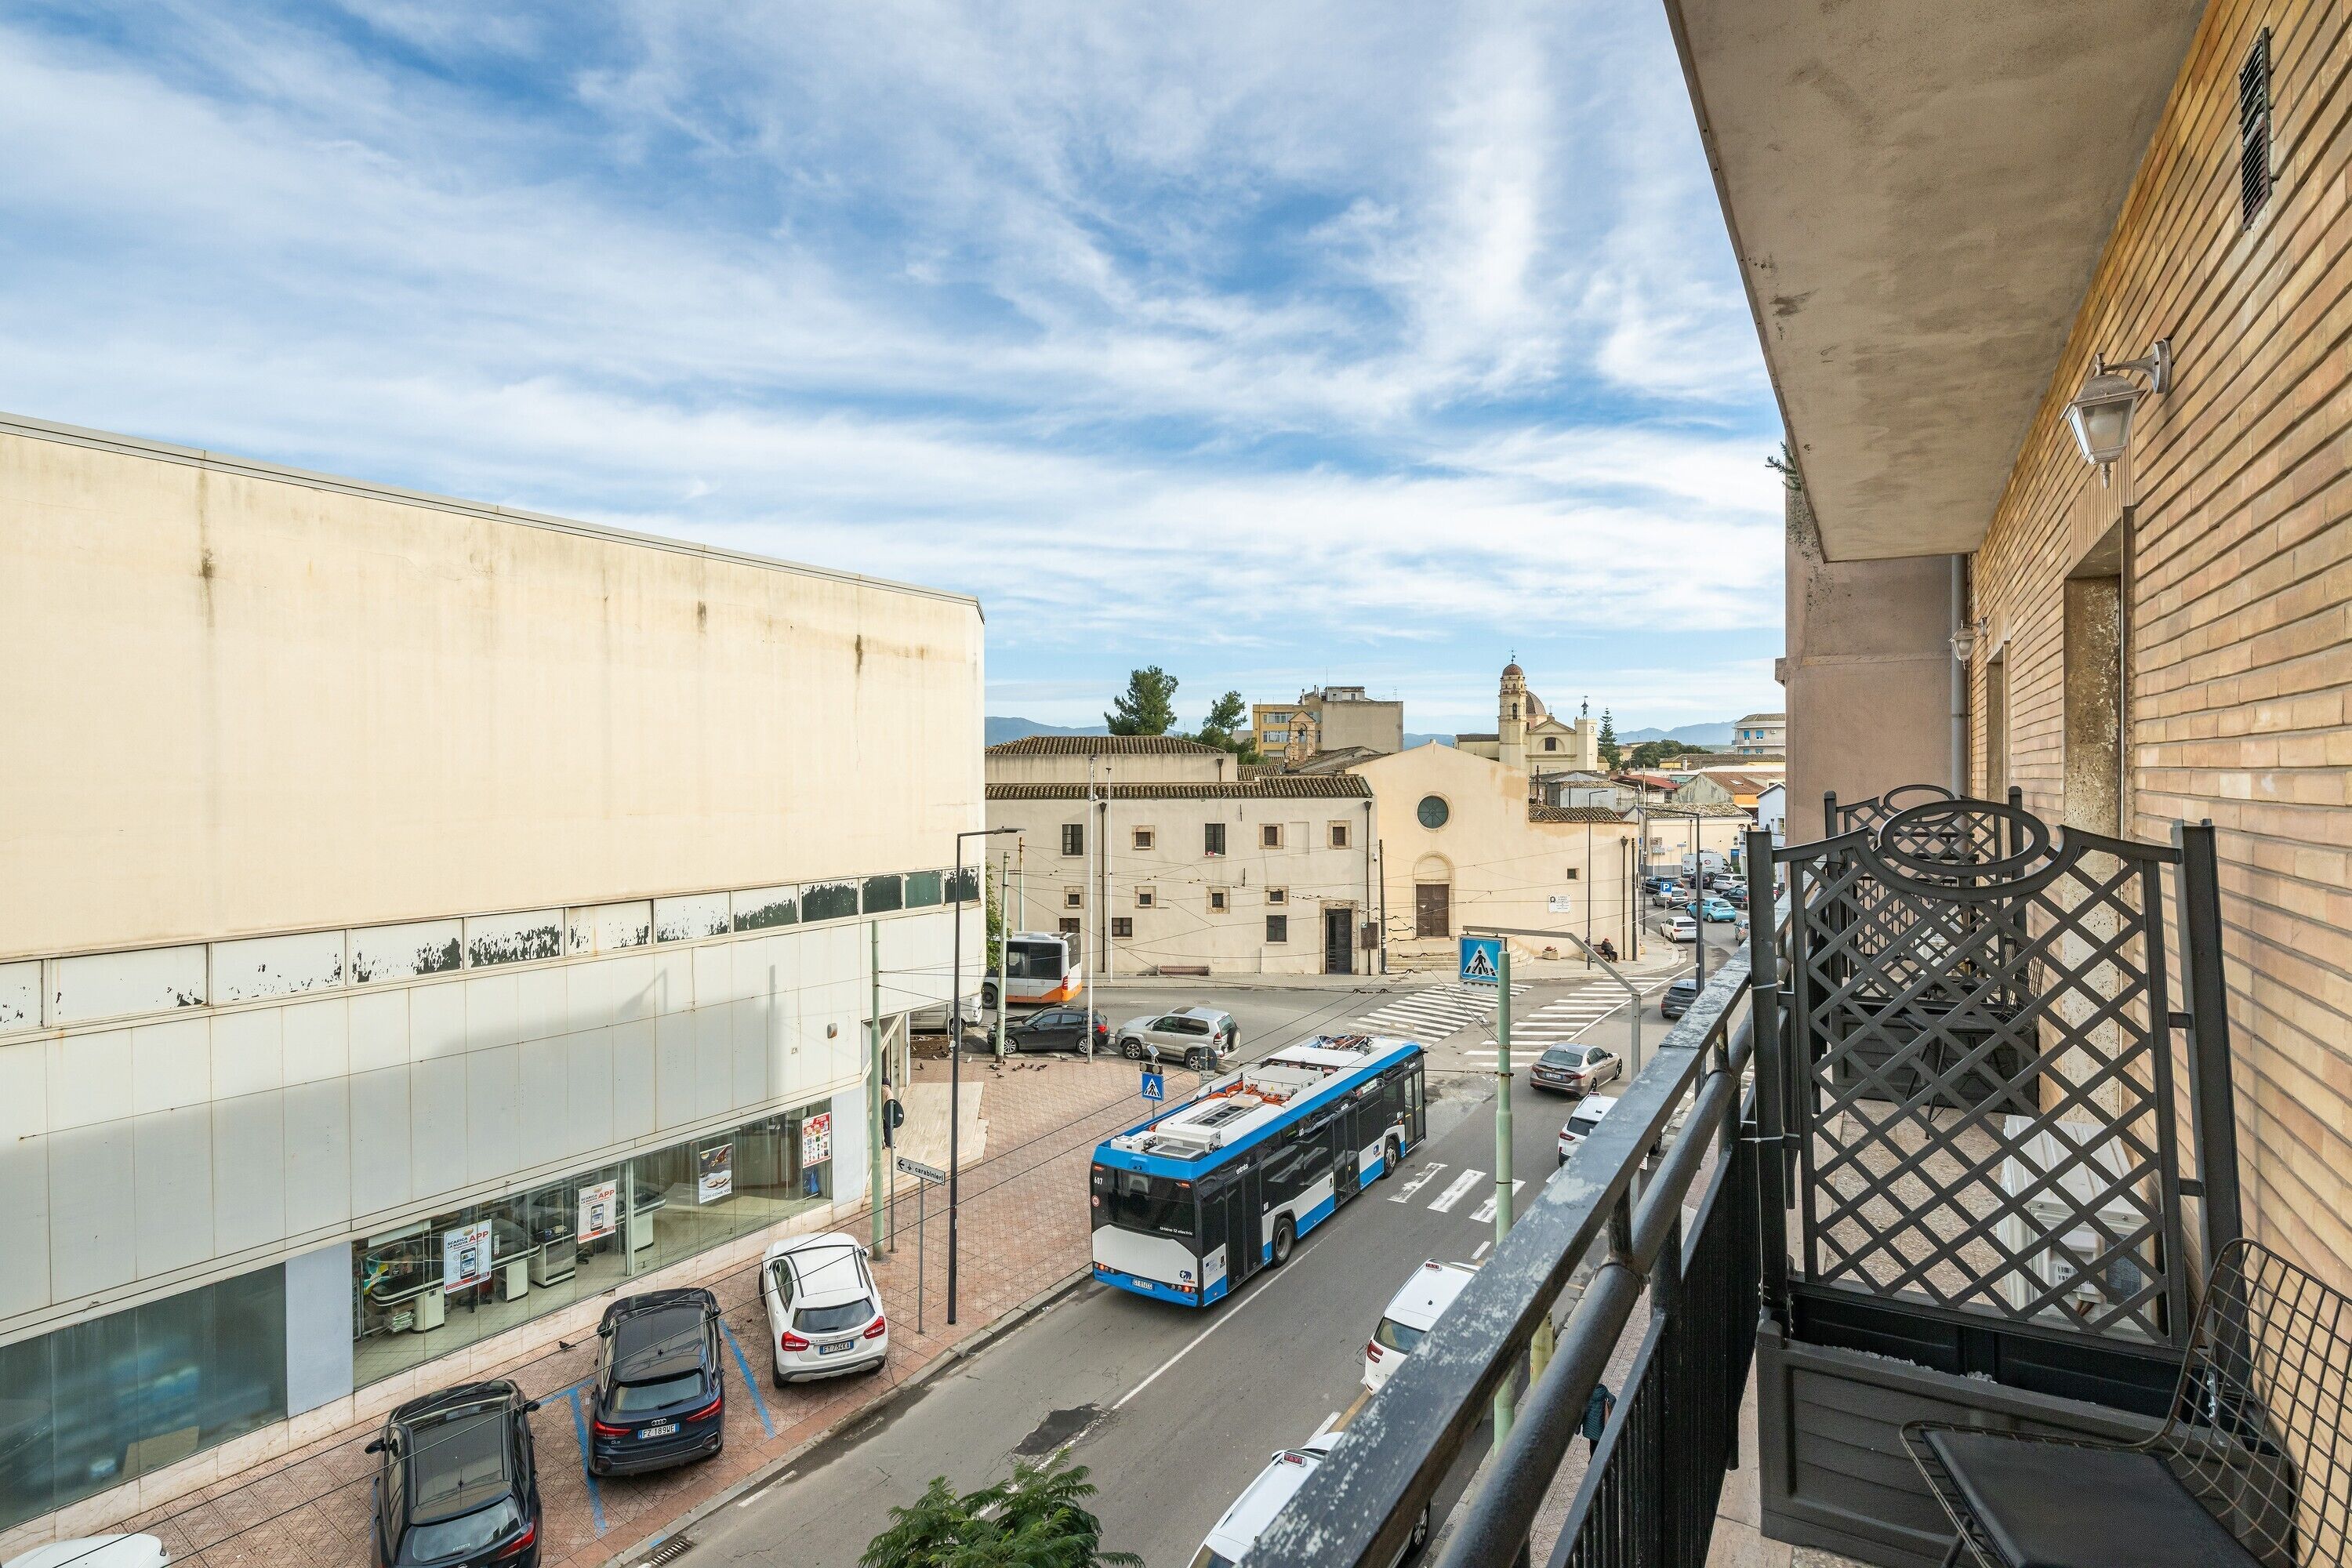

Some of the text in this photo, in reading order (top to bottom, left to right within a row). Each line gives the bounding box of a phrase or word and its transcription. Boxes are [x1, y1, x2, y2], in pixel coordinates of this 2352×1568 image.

[1663, 883, 1670, 891] P
[914, 1167, 944, 1181] carabinieri
[1236, 1163, 1249, 1175] entrata
[1094, 1176, 1103, 1185] 607
[598, 1189, 615, 1199] APP
[448, 1237, 468, 1246] SCARICA
[469, 1231, 489, 1243] APP
[643, 1425, 675, 1438] FZ 189WE
[1285, 1454, 1301, 1464] TAXI
